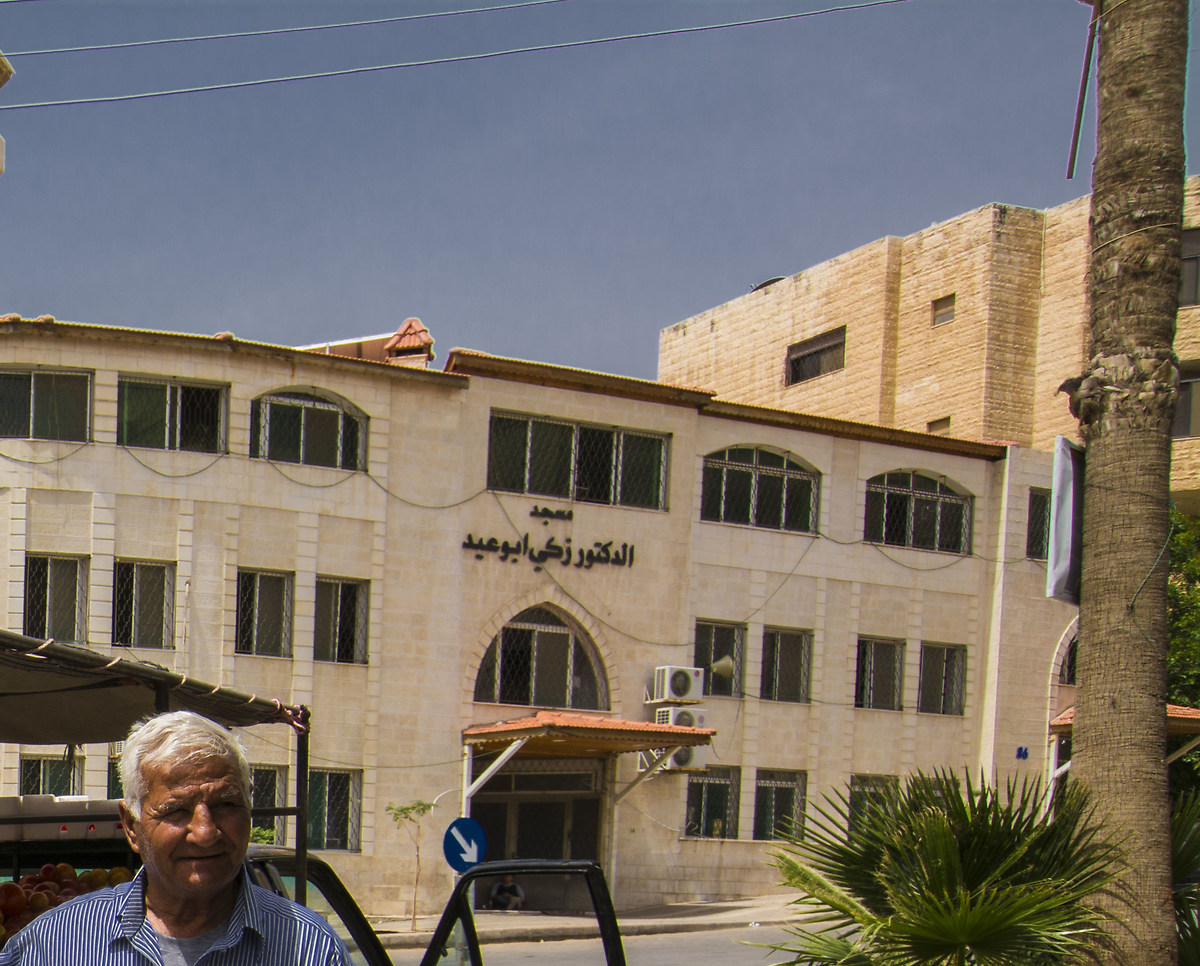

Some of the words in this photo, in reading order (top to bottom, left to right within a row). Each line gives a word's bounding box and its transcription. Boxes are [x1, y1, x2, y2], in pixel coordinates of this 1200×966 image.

[529, 505, 574, 527] مسجد
[528, 536, 572, 573] زكي
[573, 540, 635, 570] الدكتور
